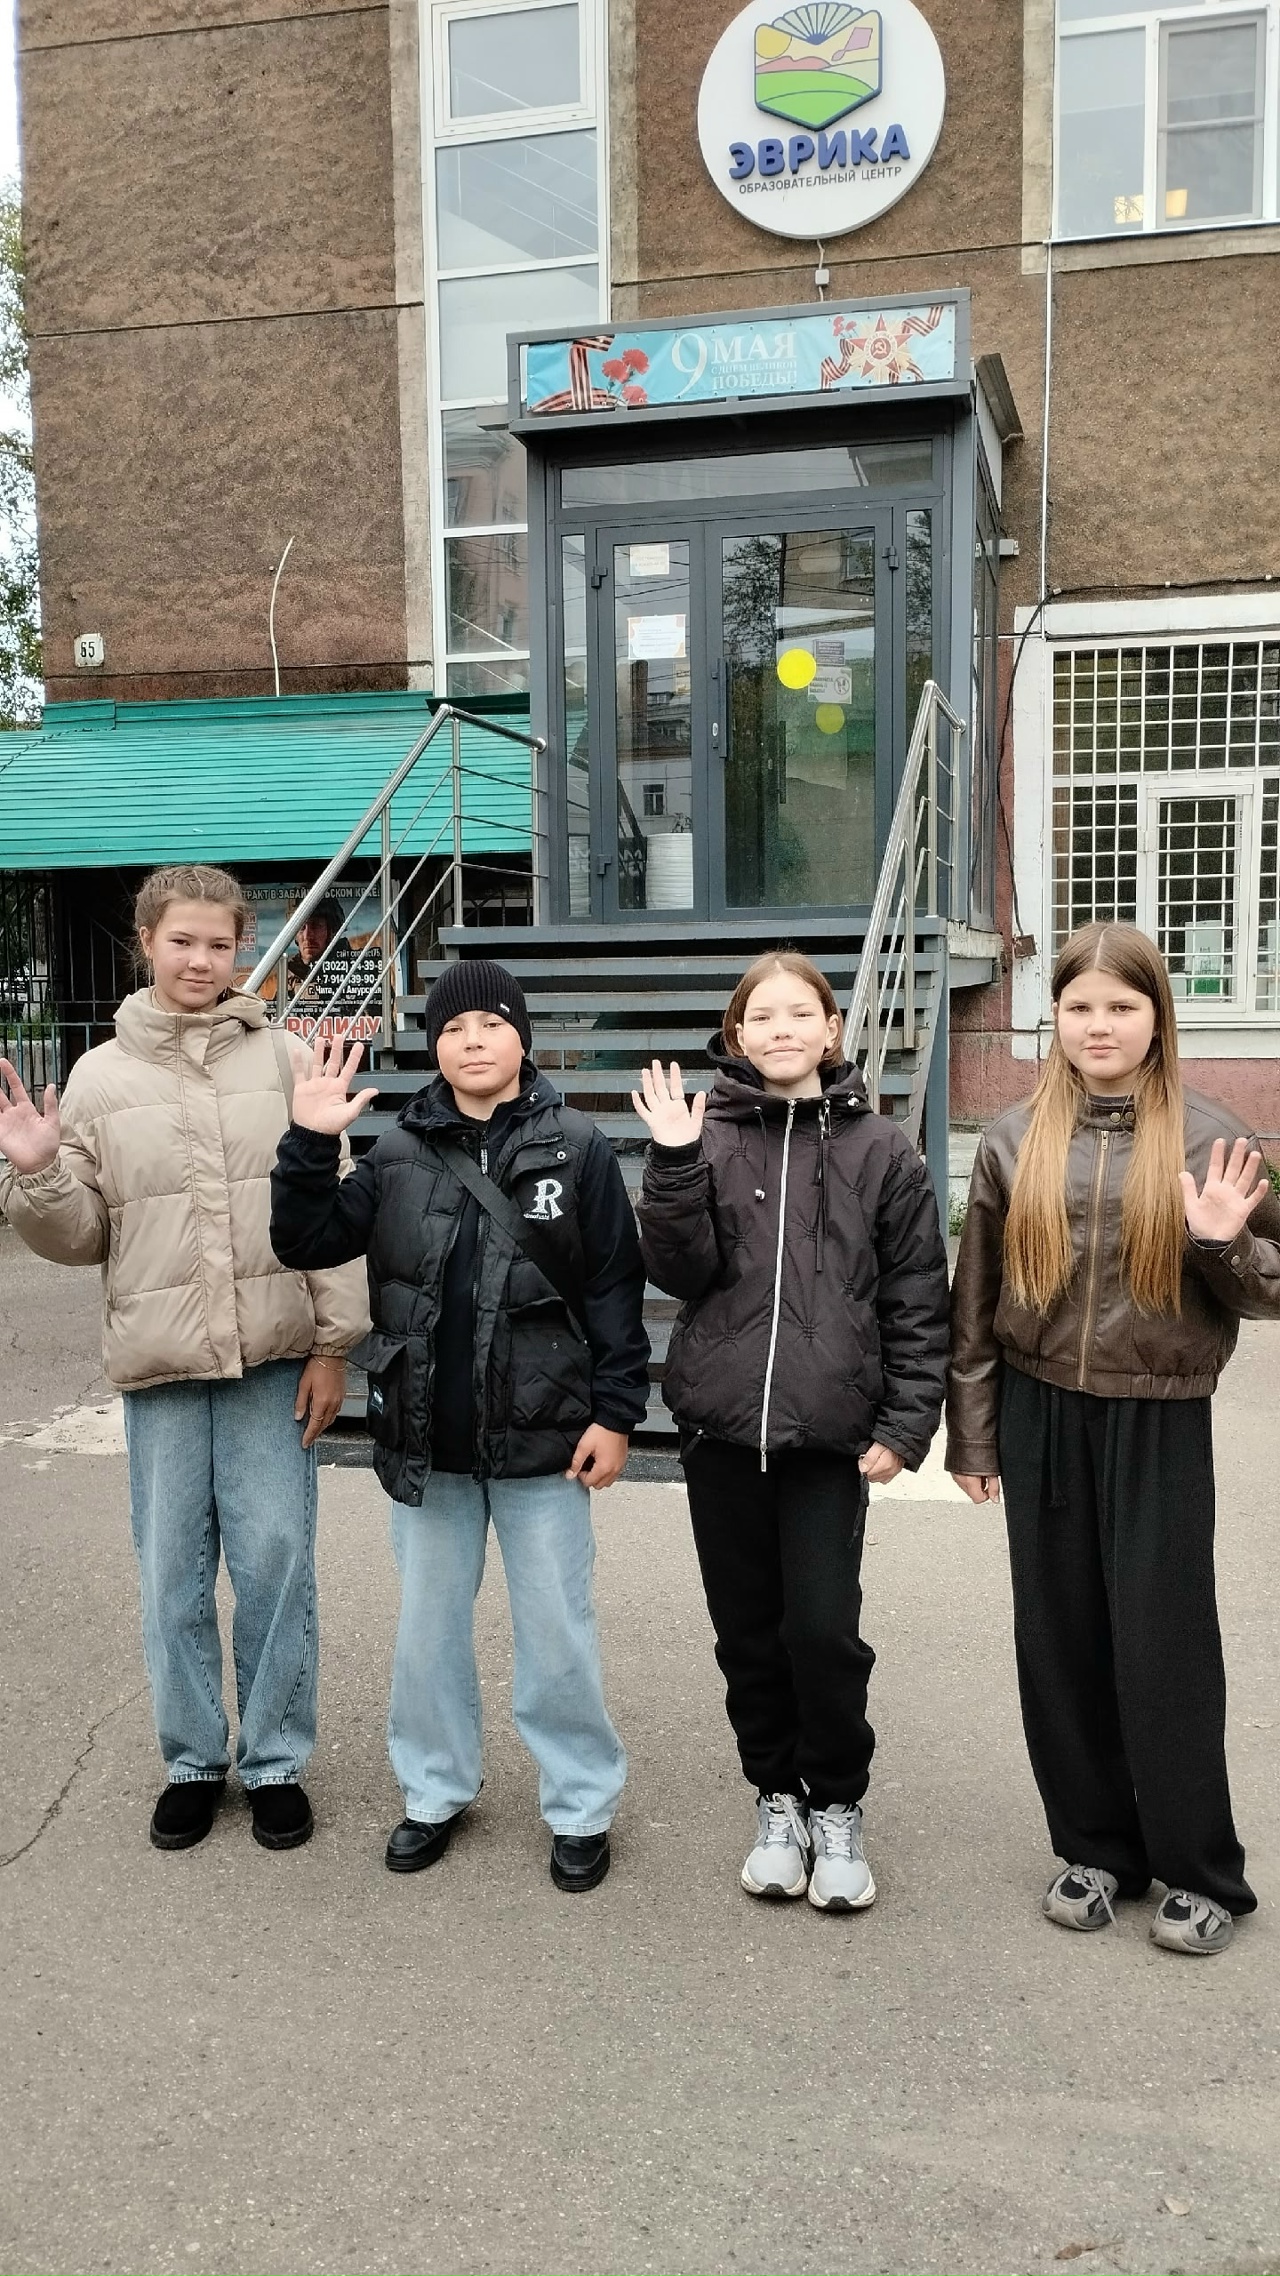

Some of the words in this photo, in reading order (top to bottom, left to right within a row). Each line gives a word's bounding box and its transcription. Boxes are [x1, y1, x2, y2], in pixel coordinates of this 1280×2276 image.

[728, 123, 911, 180] ЭВРИКА
[738, 170, 856, 194] ОБРАЗОВАТЕЛЬНЫЙ
[861, 166, 902, 182] ЦЕНТР
[671, 332, 708, 398] 9
[711, 331, 797, 364] МАЯ
[711, 370, 798, 391] ПОБЕДЫ!
[80, 641, 95, 658] 65
[278, 886, 353, 900] ЗАБАЙЬСКОМ
[322, 960, 349, 973] (3022)
[286, 1016, 381, 1041] РОДИНУ
[531, 1178, 564, 1220] R
